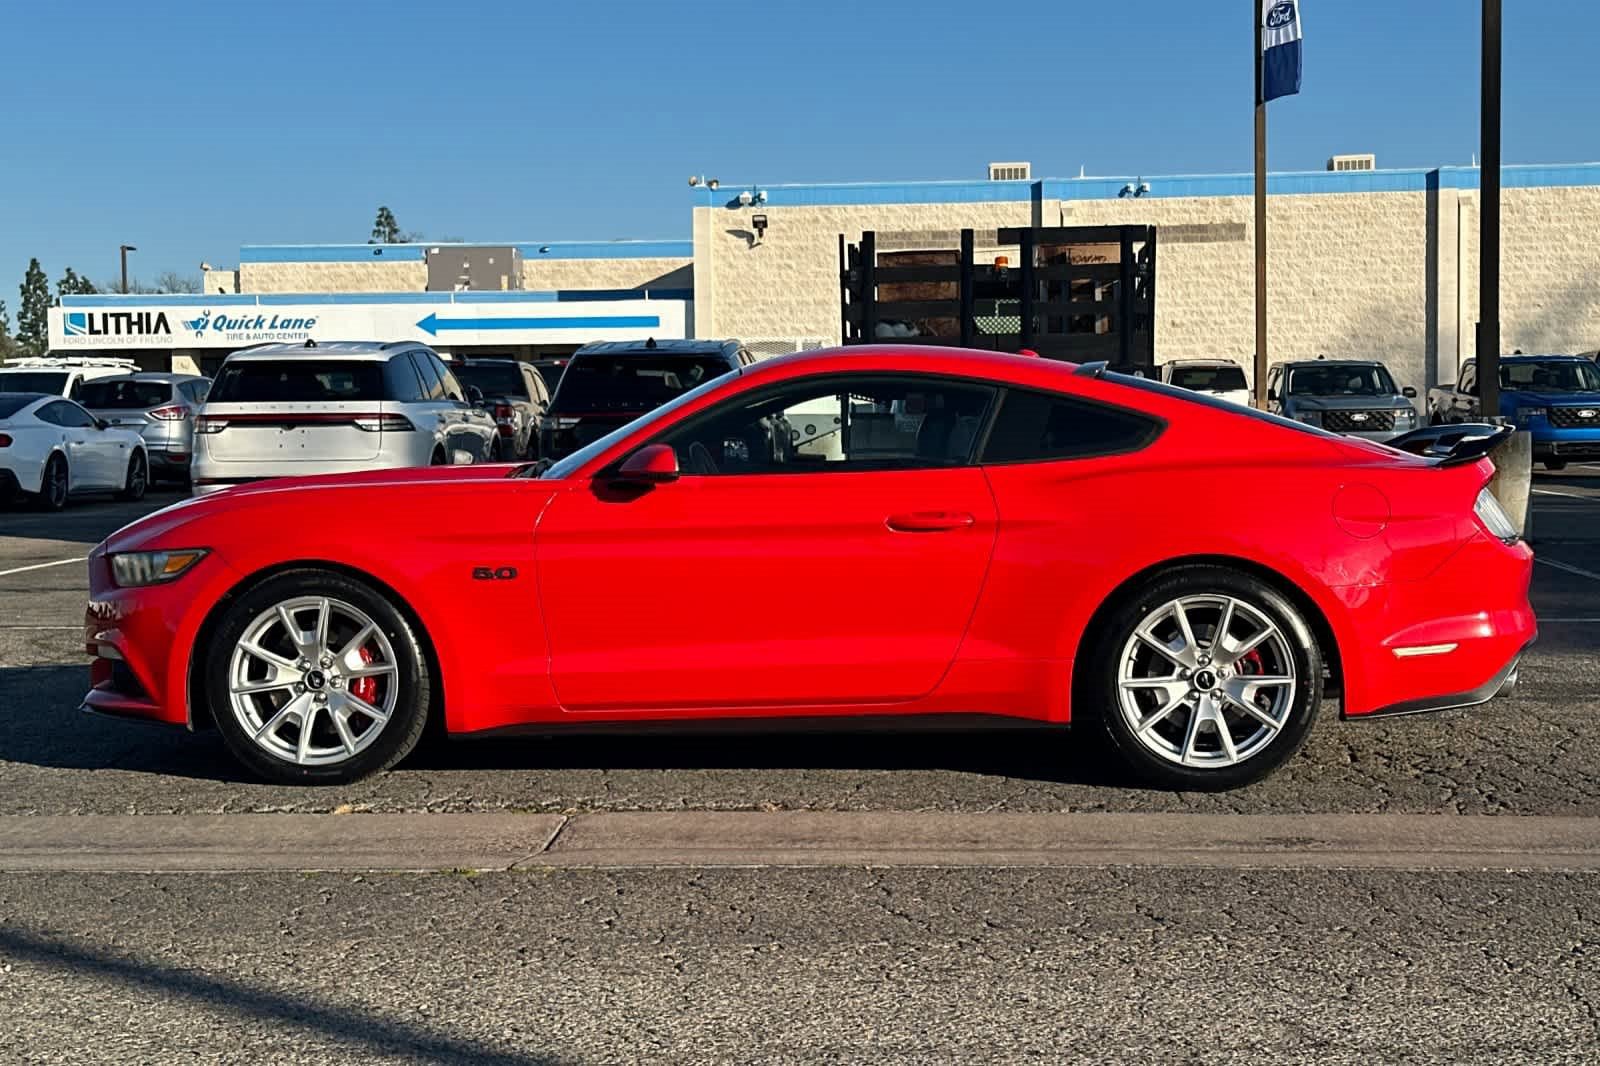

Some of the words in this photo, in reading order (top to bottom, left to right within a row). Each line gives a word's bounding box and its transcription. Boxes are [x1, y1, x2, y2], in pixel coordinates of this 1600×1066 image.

[1270, 6, 1291, 26] Ford
[88, 312, 172, 335] LITHIA
[212, 314, 266, 332] Quick
[268, 314, 316, 330] Lane
[63, 335, 87, 345] FORD
[88, 335, 125, 345] LINCOLN
[126, 335, 137, 344] OF
[226, 332, 245, 341] TIRE
[252, 332, 275, 340] AUTO
[276, 332, 309, 340] CENTER
